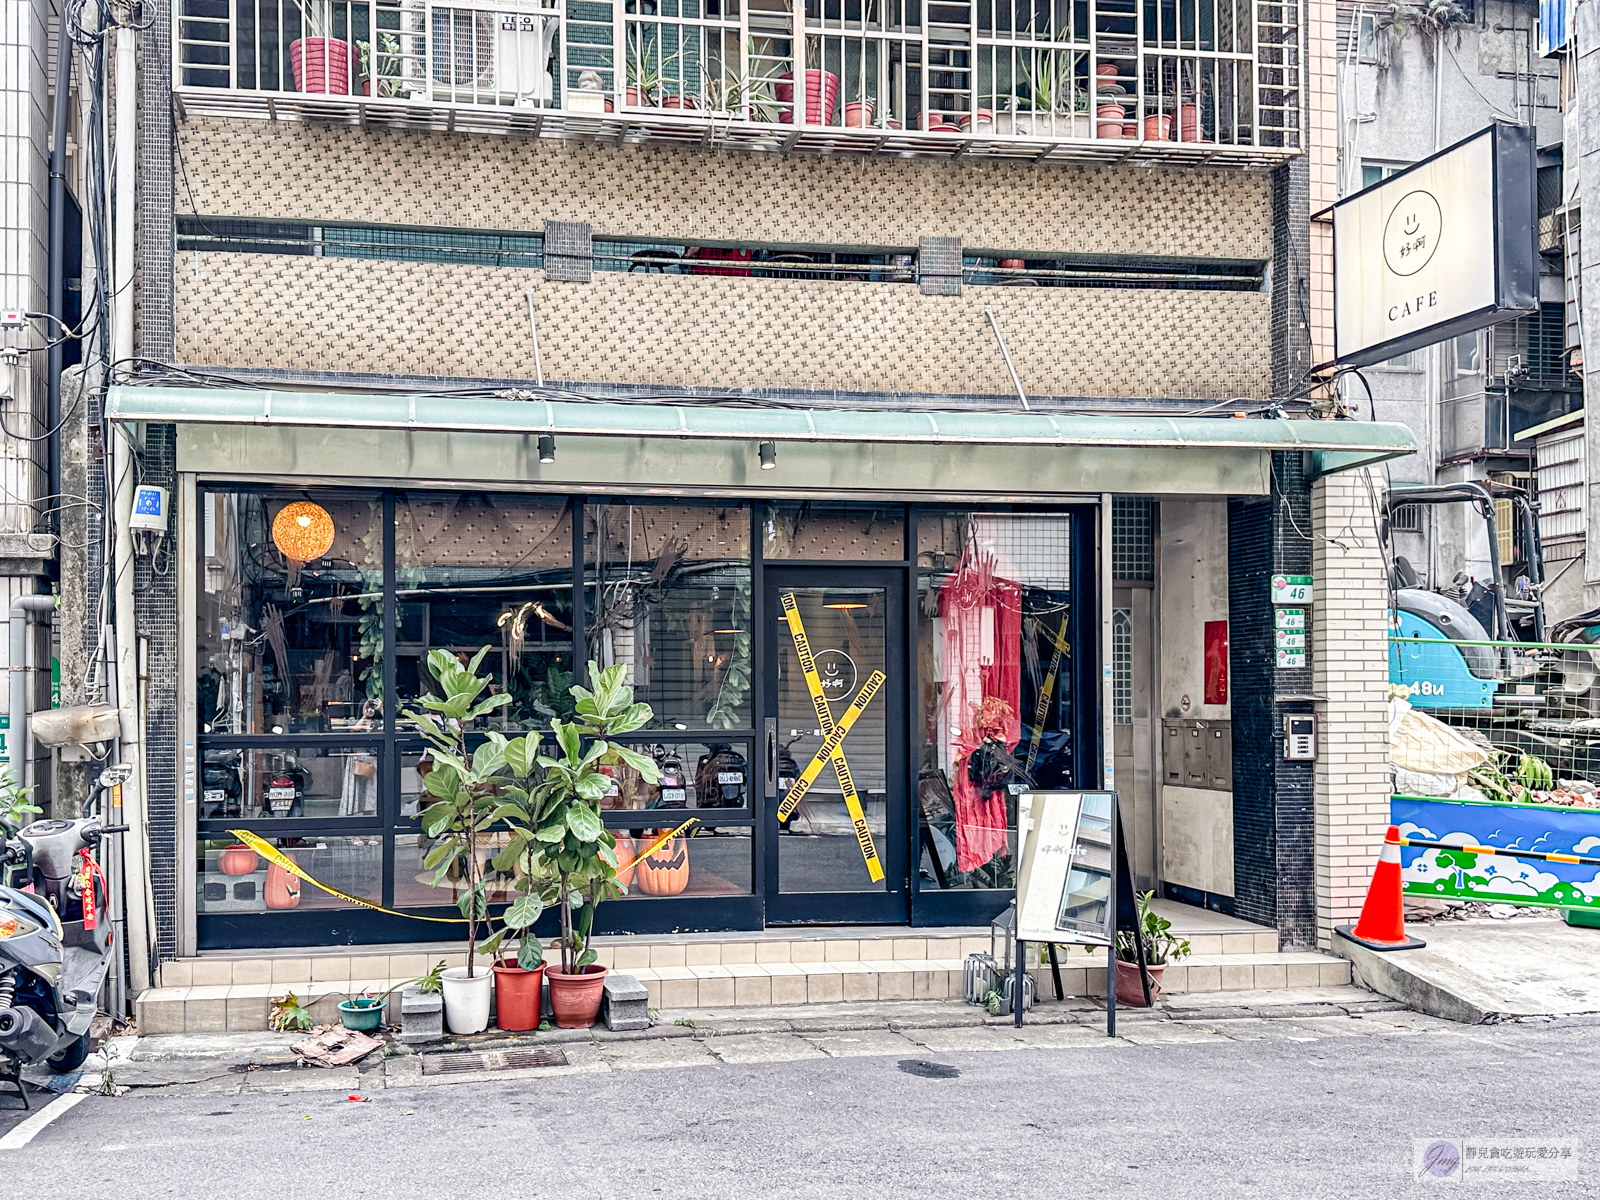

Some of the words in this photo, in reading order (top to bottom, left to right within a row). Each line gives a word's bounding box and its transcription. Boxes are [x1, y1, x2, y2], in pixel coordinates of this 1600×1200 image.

[1398, 234, 1427, 259] 好啊
[1388, 291, 1439, 322] CAFE
[1290, 587, 1305, 600] 46
[1285, 618, 1296, 626] 46
[793, 632, 815, 674] CAUTION
[1286, 637, 1296, 646] 46
[1286, 657, 1297, 665] 46
[820, 678, 844, 689] 好啊
[853, 670, 883, 710] CAUTION
[813, 694, 835, 736] CAUTION
[1035, 693, 1049, 728] CAUTION
[816, 725, 846, 764] CAUTION
[833, 757, 854, 798] CAUTION
[779, 778, 809, 817] CAUTION
[854, 818, 875, 860] CAUTION
